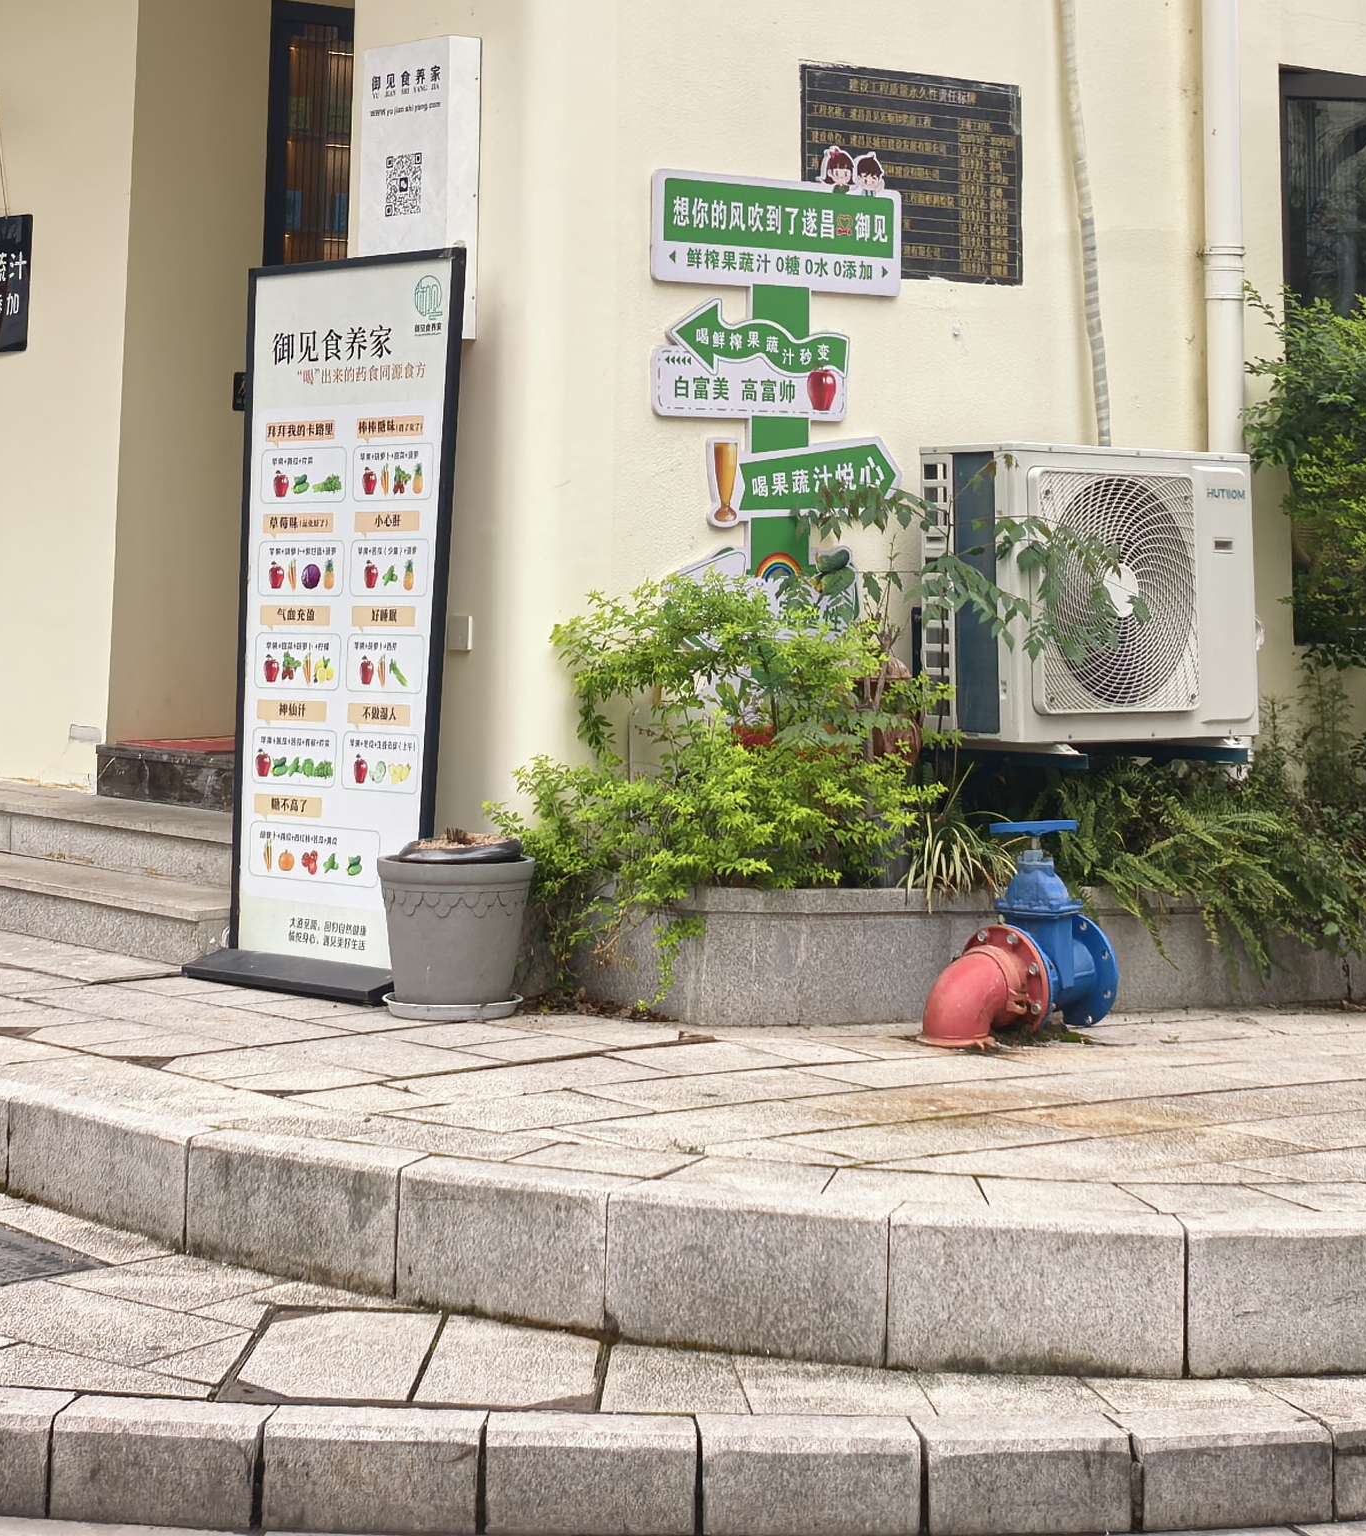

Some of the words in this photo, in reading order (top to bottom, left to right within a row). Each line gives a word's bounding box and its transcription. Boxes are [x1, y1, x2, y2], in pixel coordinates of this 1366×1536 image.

[371, 64, 441, 93] 御见食养家
[672, 195, 836, 241] 想你的风吹到了遂昌
[854, 212, 889, 244] 御见
[686, 246, 772, 275] 鲜榨果蔬汁
[776, 252, 801, 278] 0糖
[805, 254, 830, 279] 0水
[833, 256, 874, 281] 0添加
[271, 324, 393, 366] 御见食养家
[695, 326, 831, 367] 喝鲜榨果蔬汁秒变
[673, 375, 730, 401] 白富美
[740, 378, 797, 405] 高富帅
[751, 456, 887, 500] 喝果蔬汁悦心
[374, 513, 402, 528] 小心肝
[270, 796, 308, 813] 糖不高了
